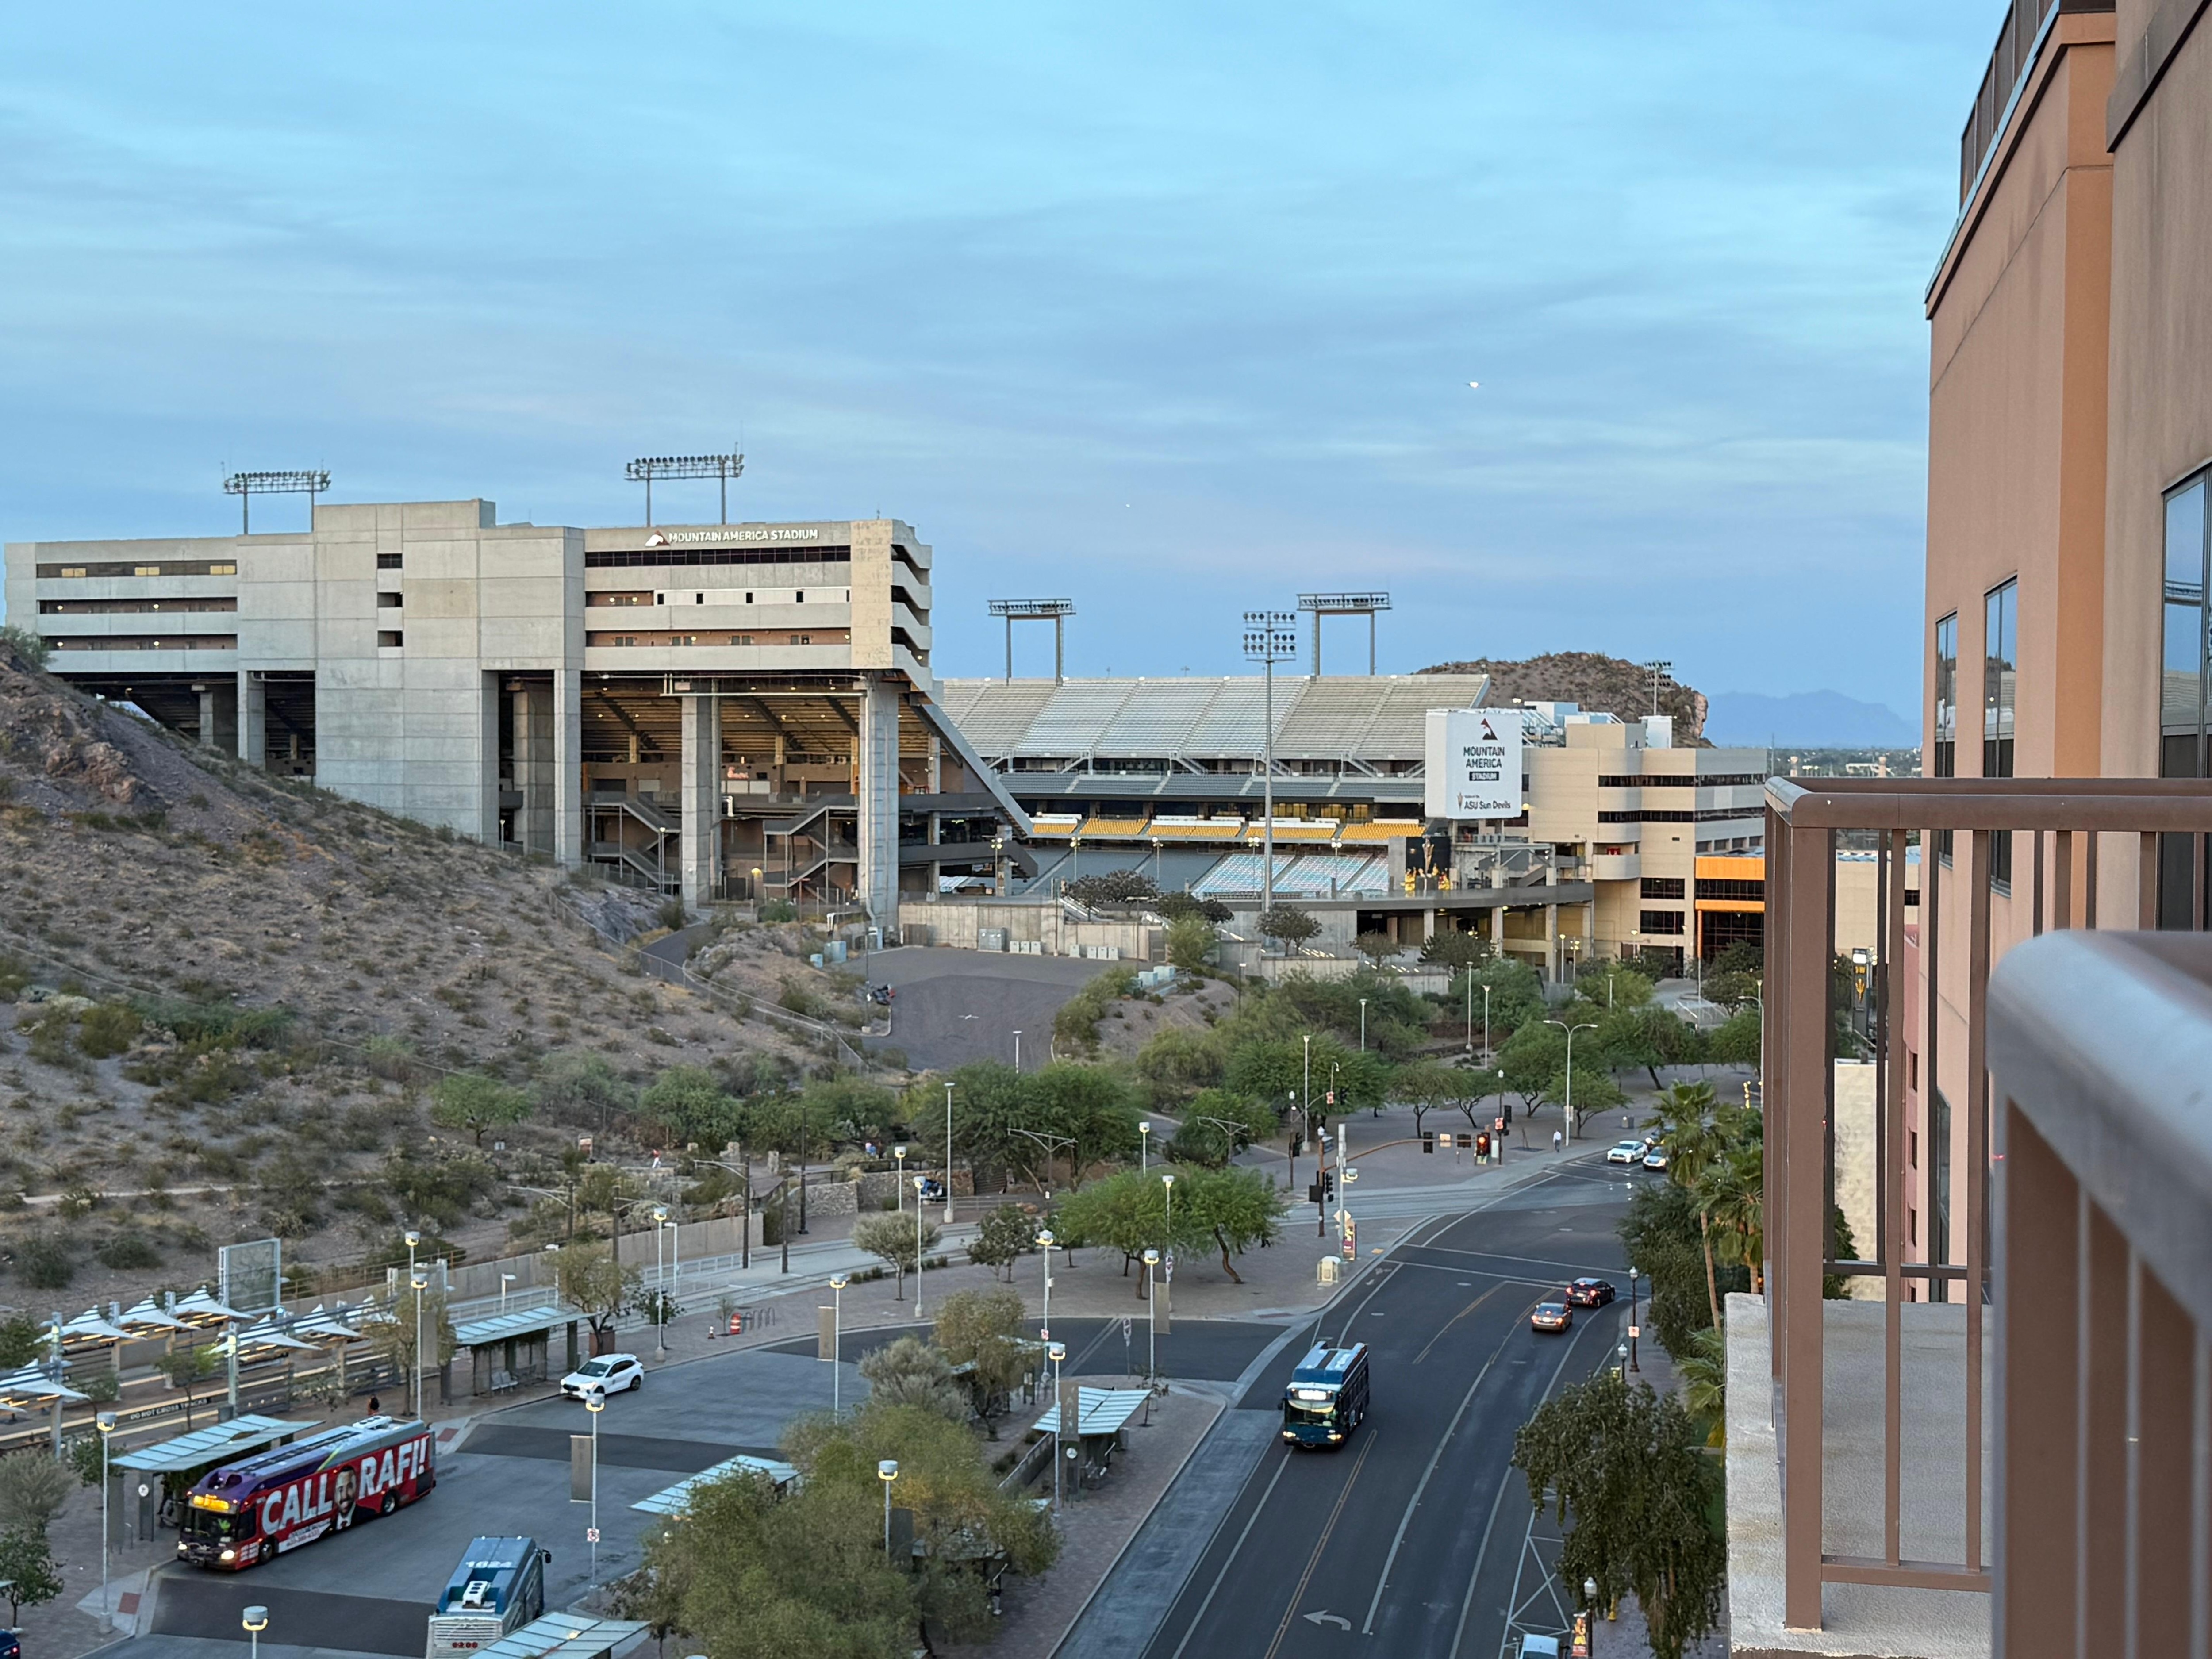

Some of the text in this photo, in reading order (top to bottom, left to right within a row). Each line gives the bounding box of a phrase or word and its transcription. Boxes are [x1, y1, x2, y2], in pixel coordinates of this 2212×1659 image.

[669, 529, 818, 542] MOUNTAIN AMERICA STADIUM
[1463, 746, 1505, 757] MOUNTAIN
[1466, 758, 1502, 768] AMERICA
[1464, 800, 1511, 810] ASU Sun Devils
[156, 1405, 179, 1414] CROSS
[261, 1438, 427, 1535] CALL RAFI!
